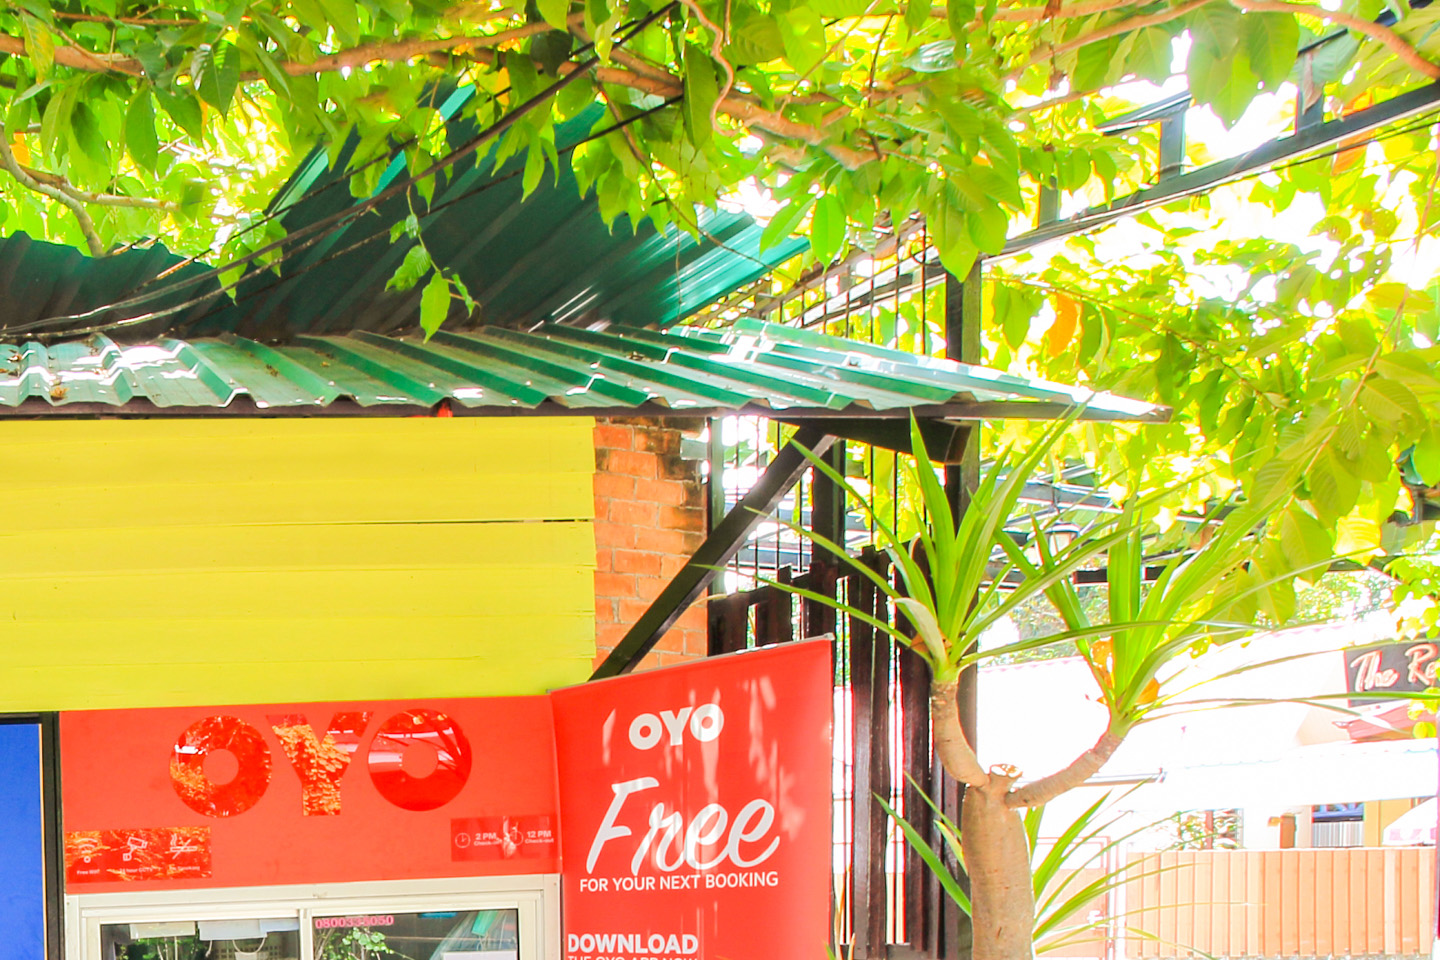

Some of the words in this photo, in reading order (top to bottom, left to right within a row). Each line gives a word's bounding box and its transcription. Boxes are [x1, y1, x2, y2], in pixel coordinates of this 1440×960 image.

[1350, 650, 1400, 692] The
[628, 702, 726, 751] OYO
[169, 708, 473, 818] OYO
[482, 832, 497, 840] PM
[537, 830, 552, 838] PM
[585, 776, 781, 876] Free
[579, 878, 609, 893] FOR
[612, 876, 657, 892] YOUR
[659, 875, 702, 891] NEXT
[705, 871, 779, 890] BOOKING
[568, 933, 699, 955] DOWNLOAD
